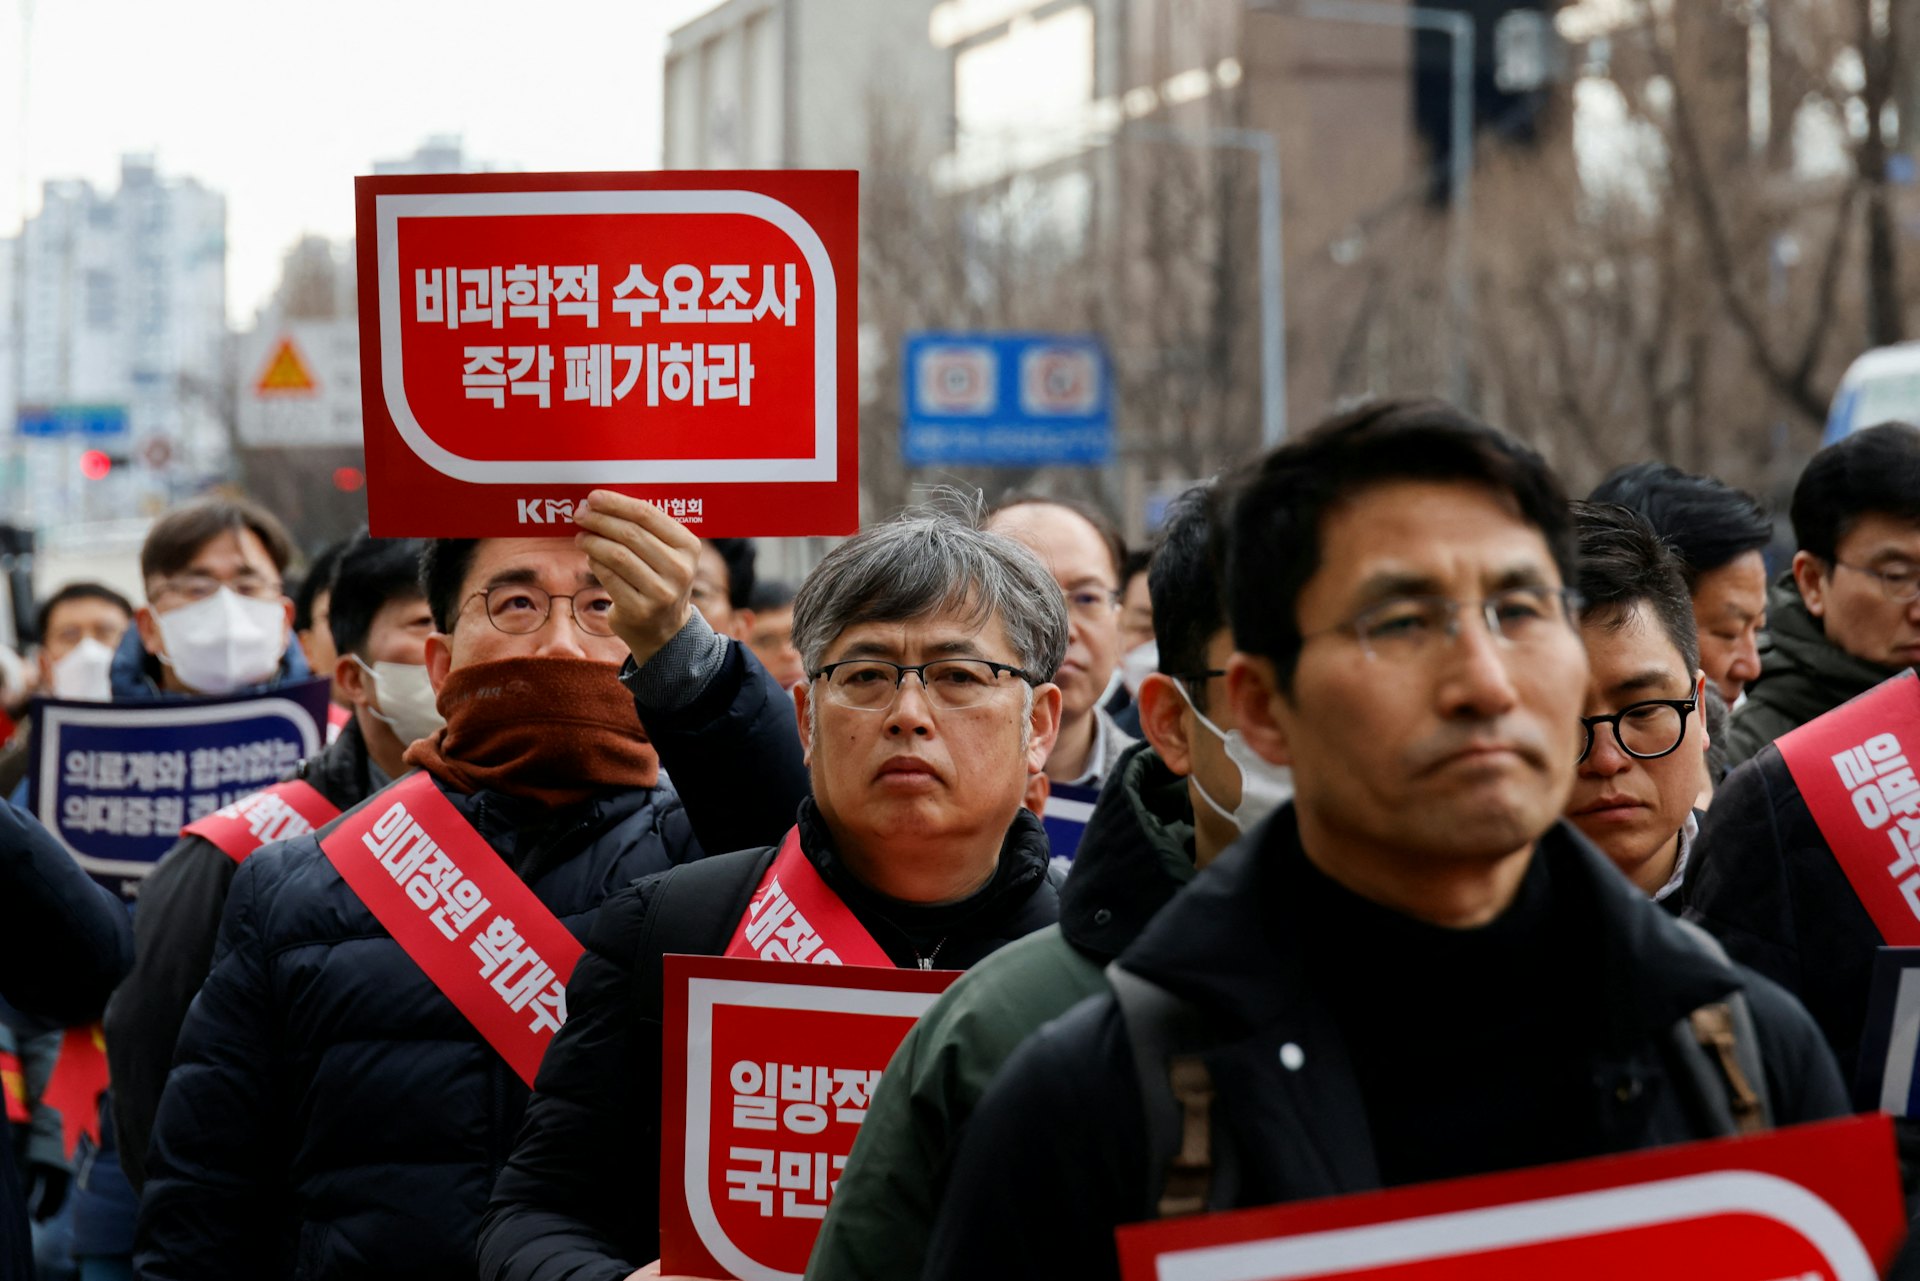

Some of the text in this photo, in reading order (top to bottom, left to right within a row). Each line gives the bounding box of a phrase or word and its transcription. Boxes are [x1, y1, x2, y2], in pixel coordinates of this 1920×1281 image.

[415, 263, 800, 330] 비과학적 수요조사
[462, 342, 755, 409] 즉각 폐기하라
[517, 498, 588, 524] KM
[648, 498, 703, 516] 사협회
[673, 516, 703, 524] OCIATION
[64, 750, 187, 791] 의료계와
[63, 794, 185, 837] 의대증원
[361, 801, 492, 942] 의대정원
[745, 876, 843, 967] 대정
[730, 1060, 883, 1135] 일방적
